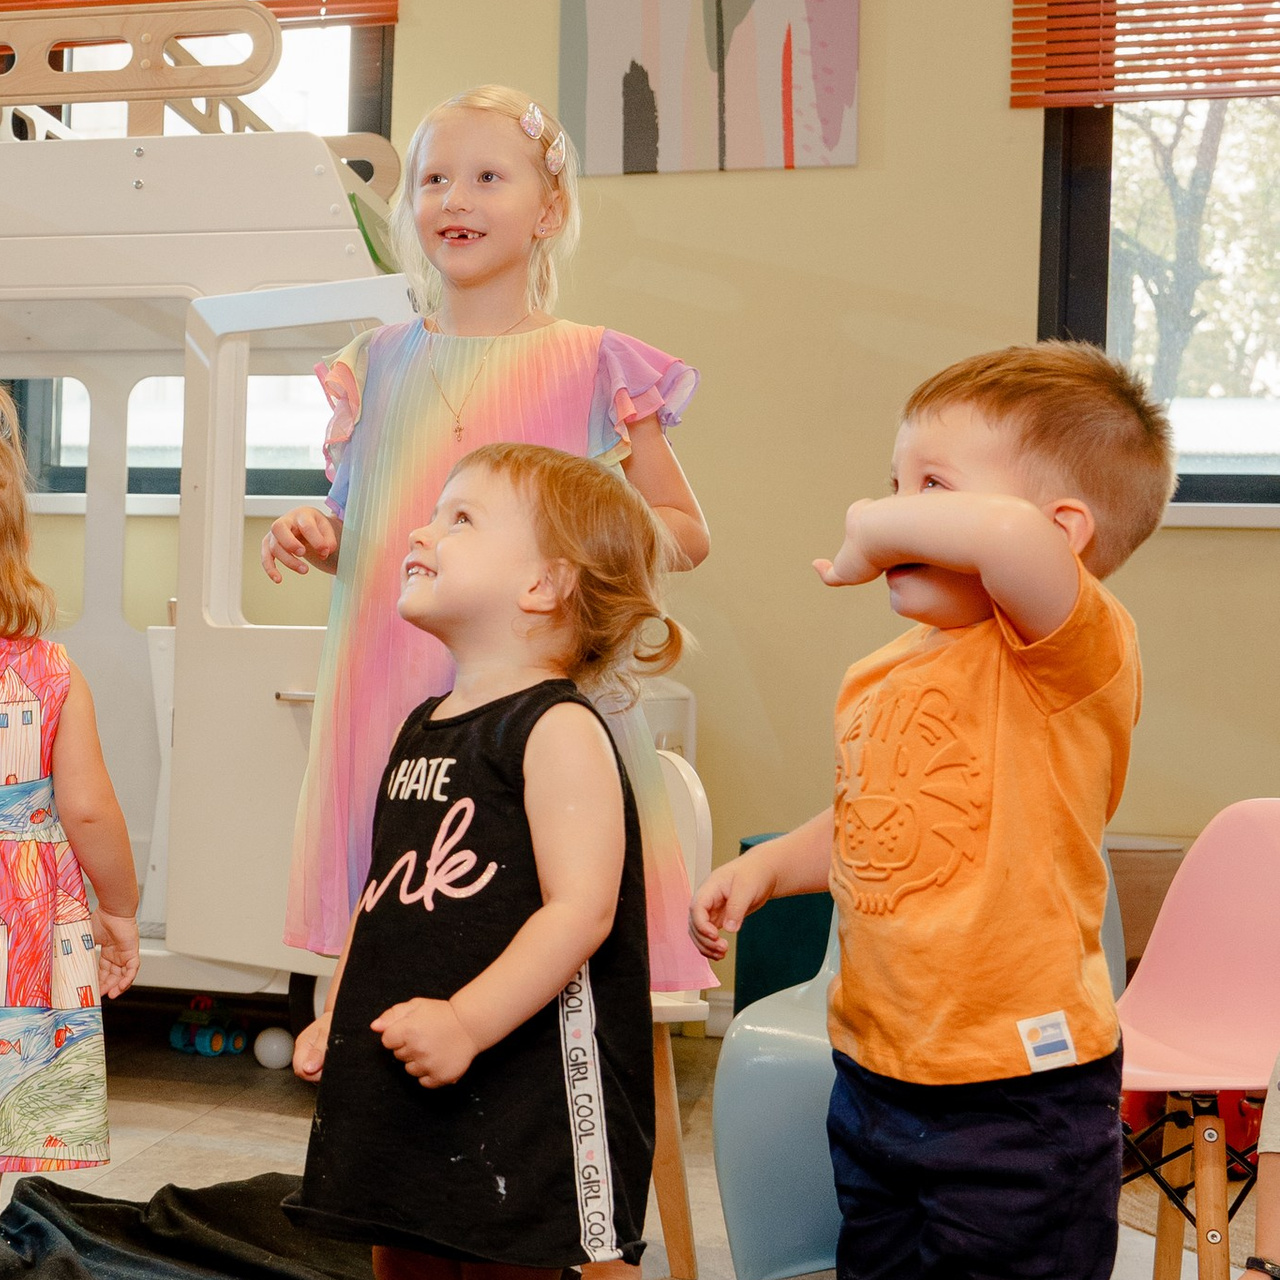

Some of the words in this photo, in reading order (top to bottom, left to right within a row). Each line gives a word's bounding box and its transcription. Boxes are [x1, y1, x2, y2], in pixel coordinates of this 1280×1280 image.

[390, 756, 457, 802] HATE
[358, 797, 498, 912] nk
[569, 1046, 590, 1090] GIRL
[574, 1093, 596, 1145] COOL
[581, 1164, 602, 1208] GIRL
[587, 1211, 606, 1253] COO
